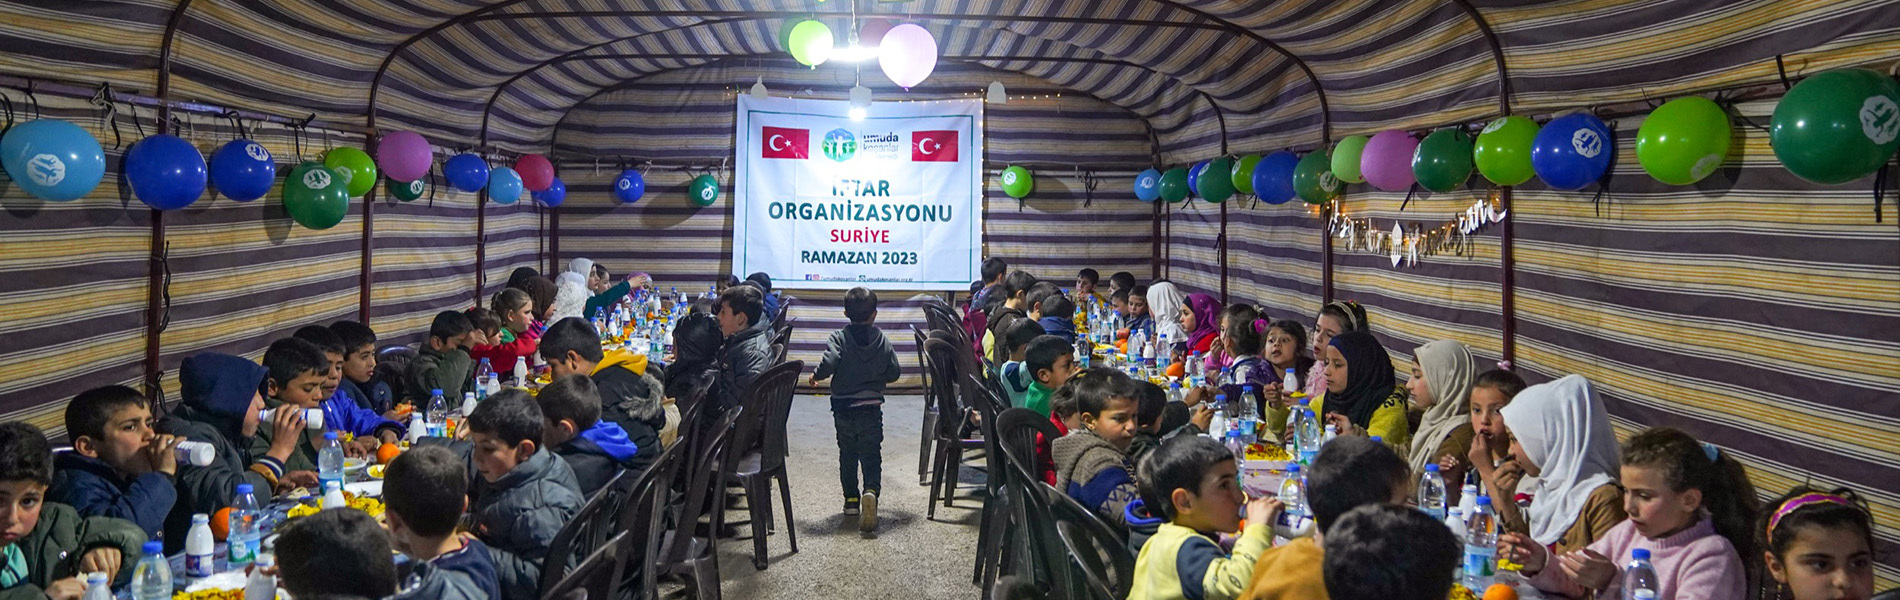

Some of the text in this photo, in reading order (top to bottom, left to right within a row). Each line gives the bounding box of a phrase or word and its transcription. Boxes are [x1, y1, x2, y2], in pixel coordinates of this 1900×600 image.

[863, 131, 899, 142] umuda
[768, 200, 953, 222] ORGANİZASYONU
[830, 227, 890, 243] SURİYE
[801, 250, 918, 265] RAMAZAN 2023
